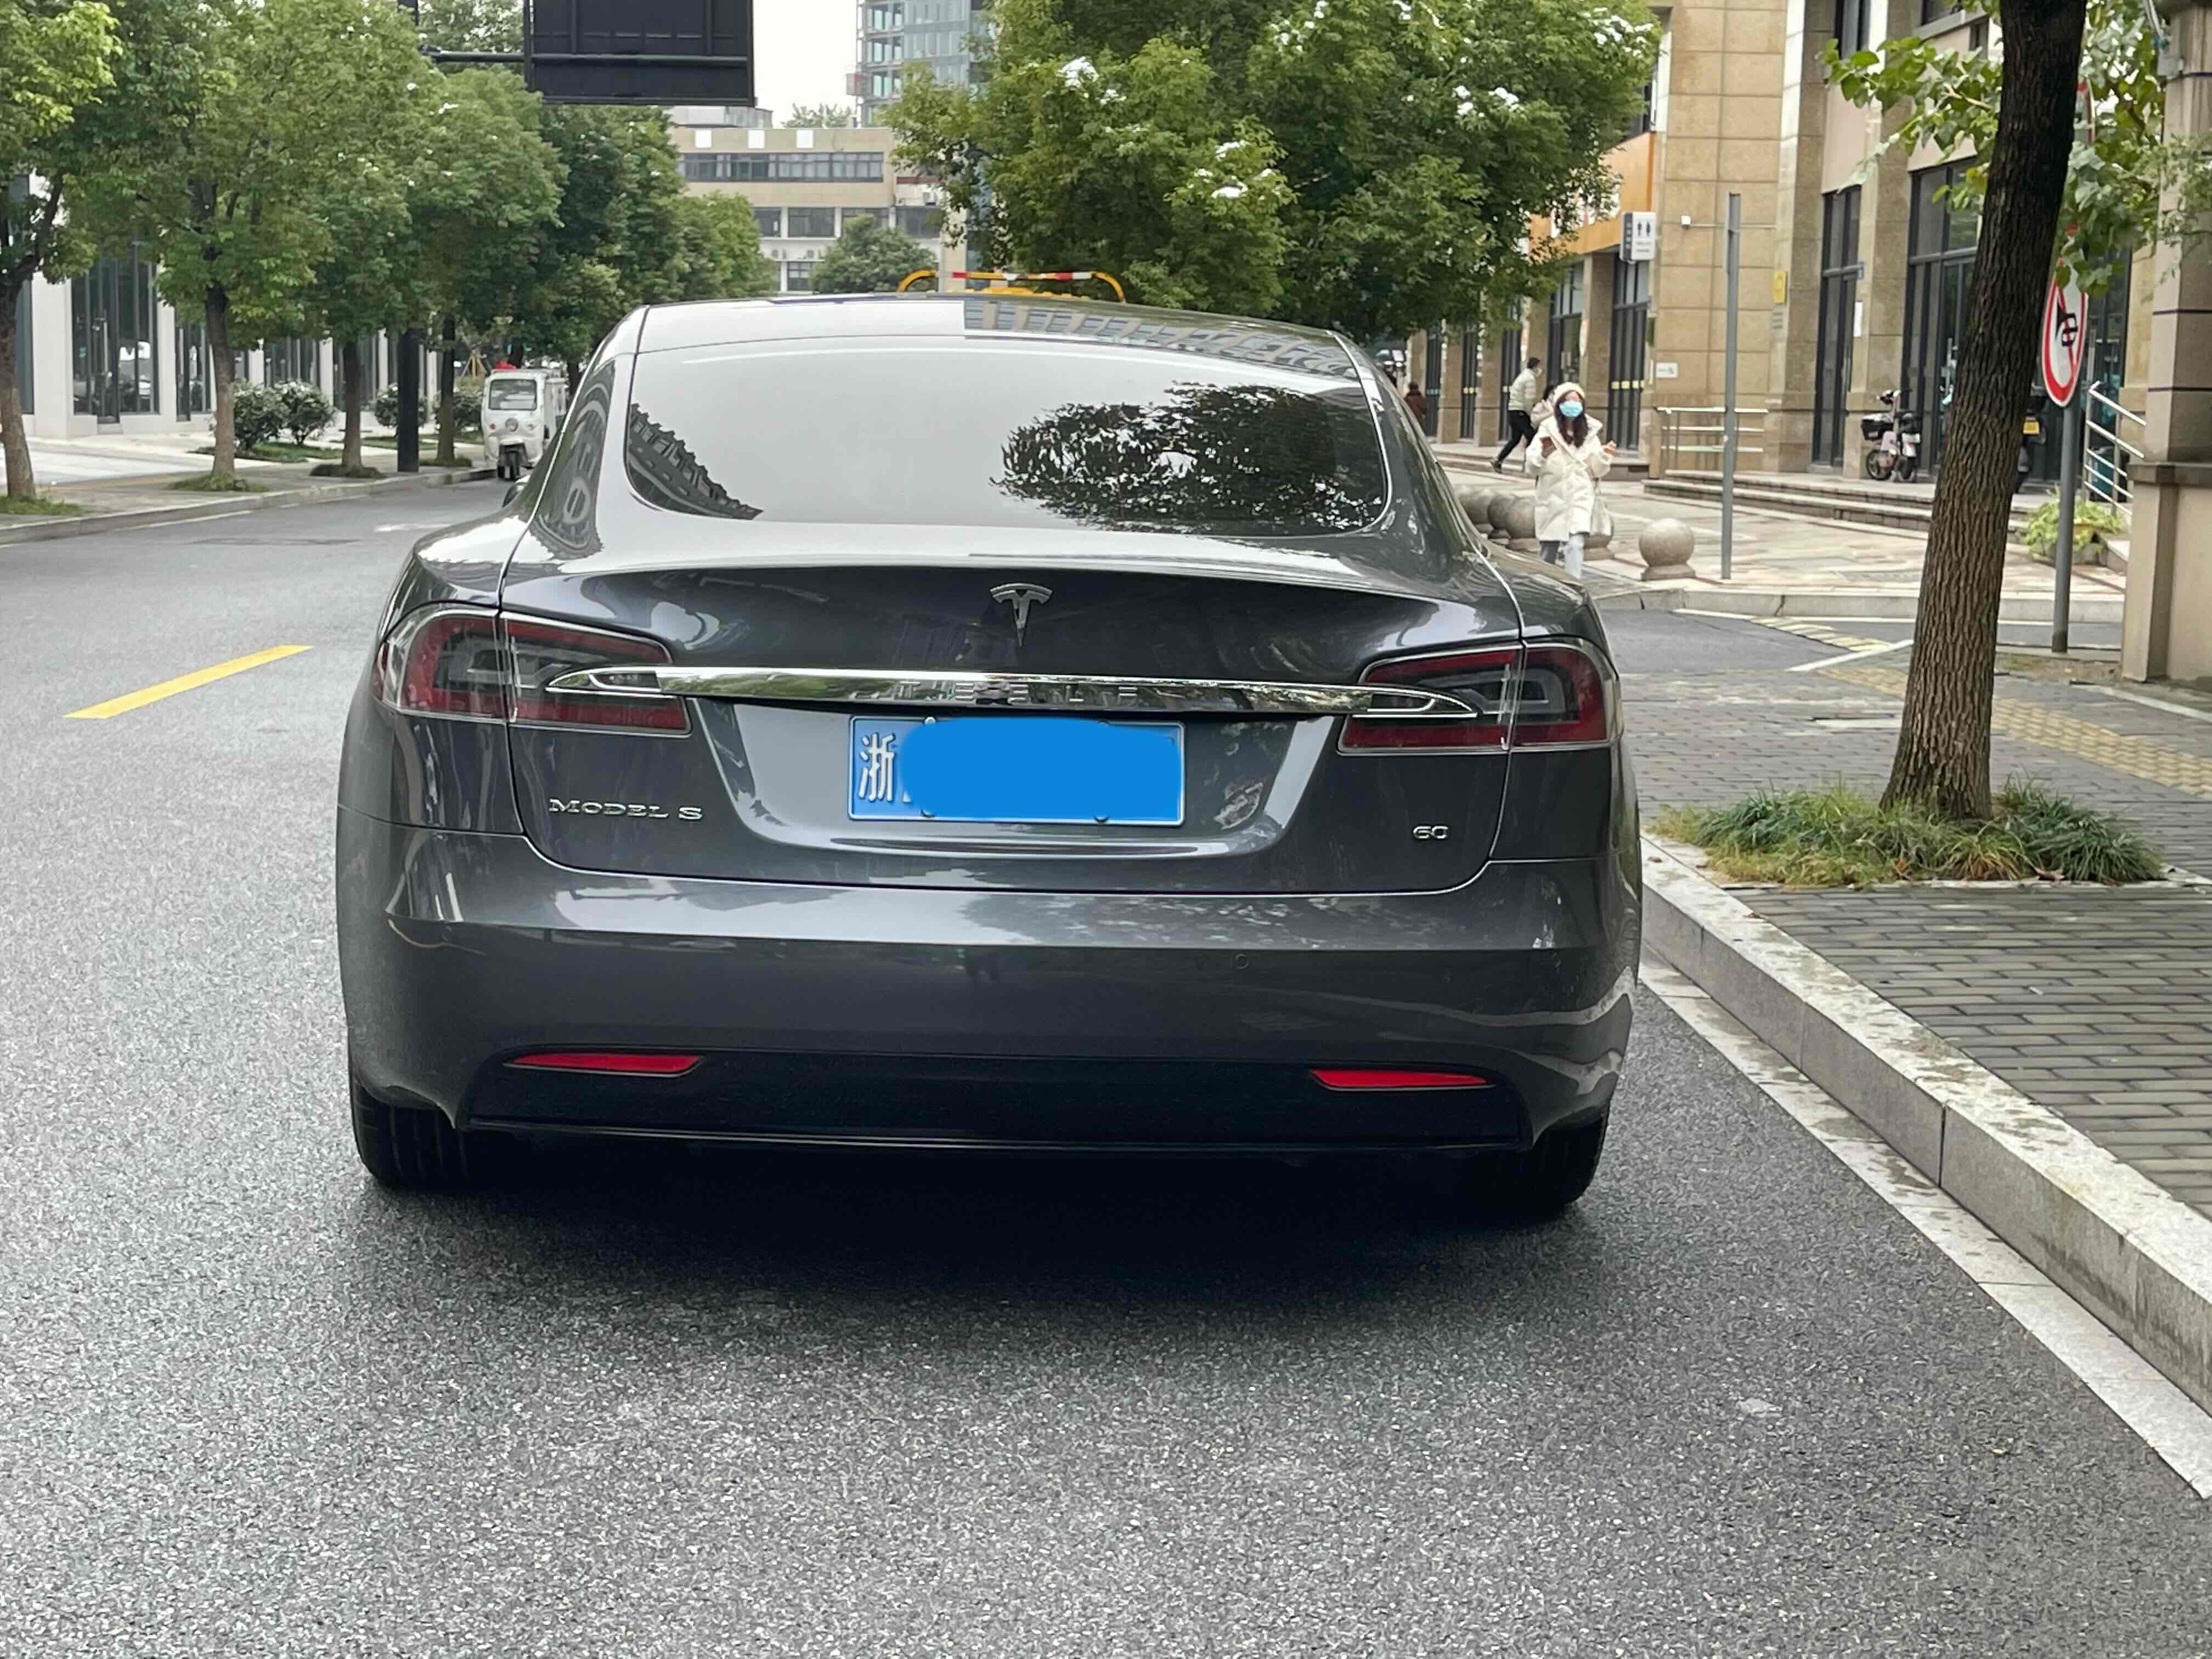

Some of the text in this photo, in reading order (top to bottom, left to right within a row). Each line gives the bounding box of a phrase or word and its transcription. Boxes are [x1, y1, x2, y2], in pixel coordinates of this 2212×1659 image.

[858, 732, 912, 803] 浙
[549, 798, 703, 821] MODEL S
